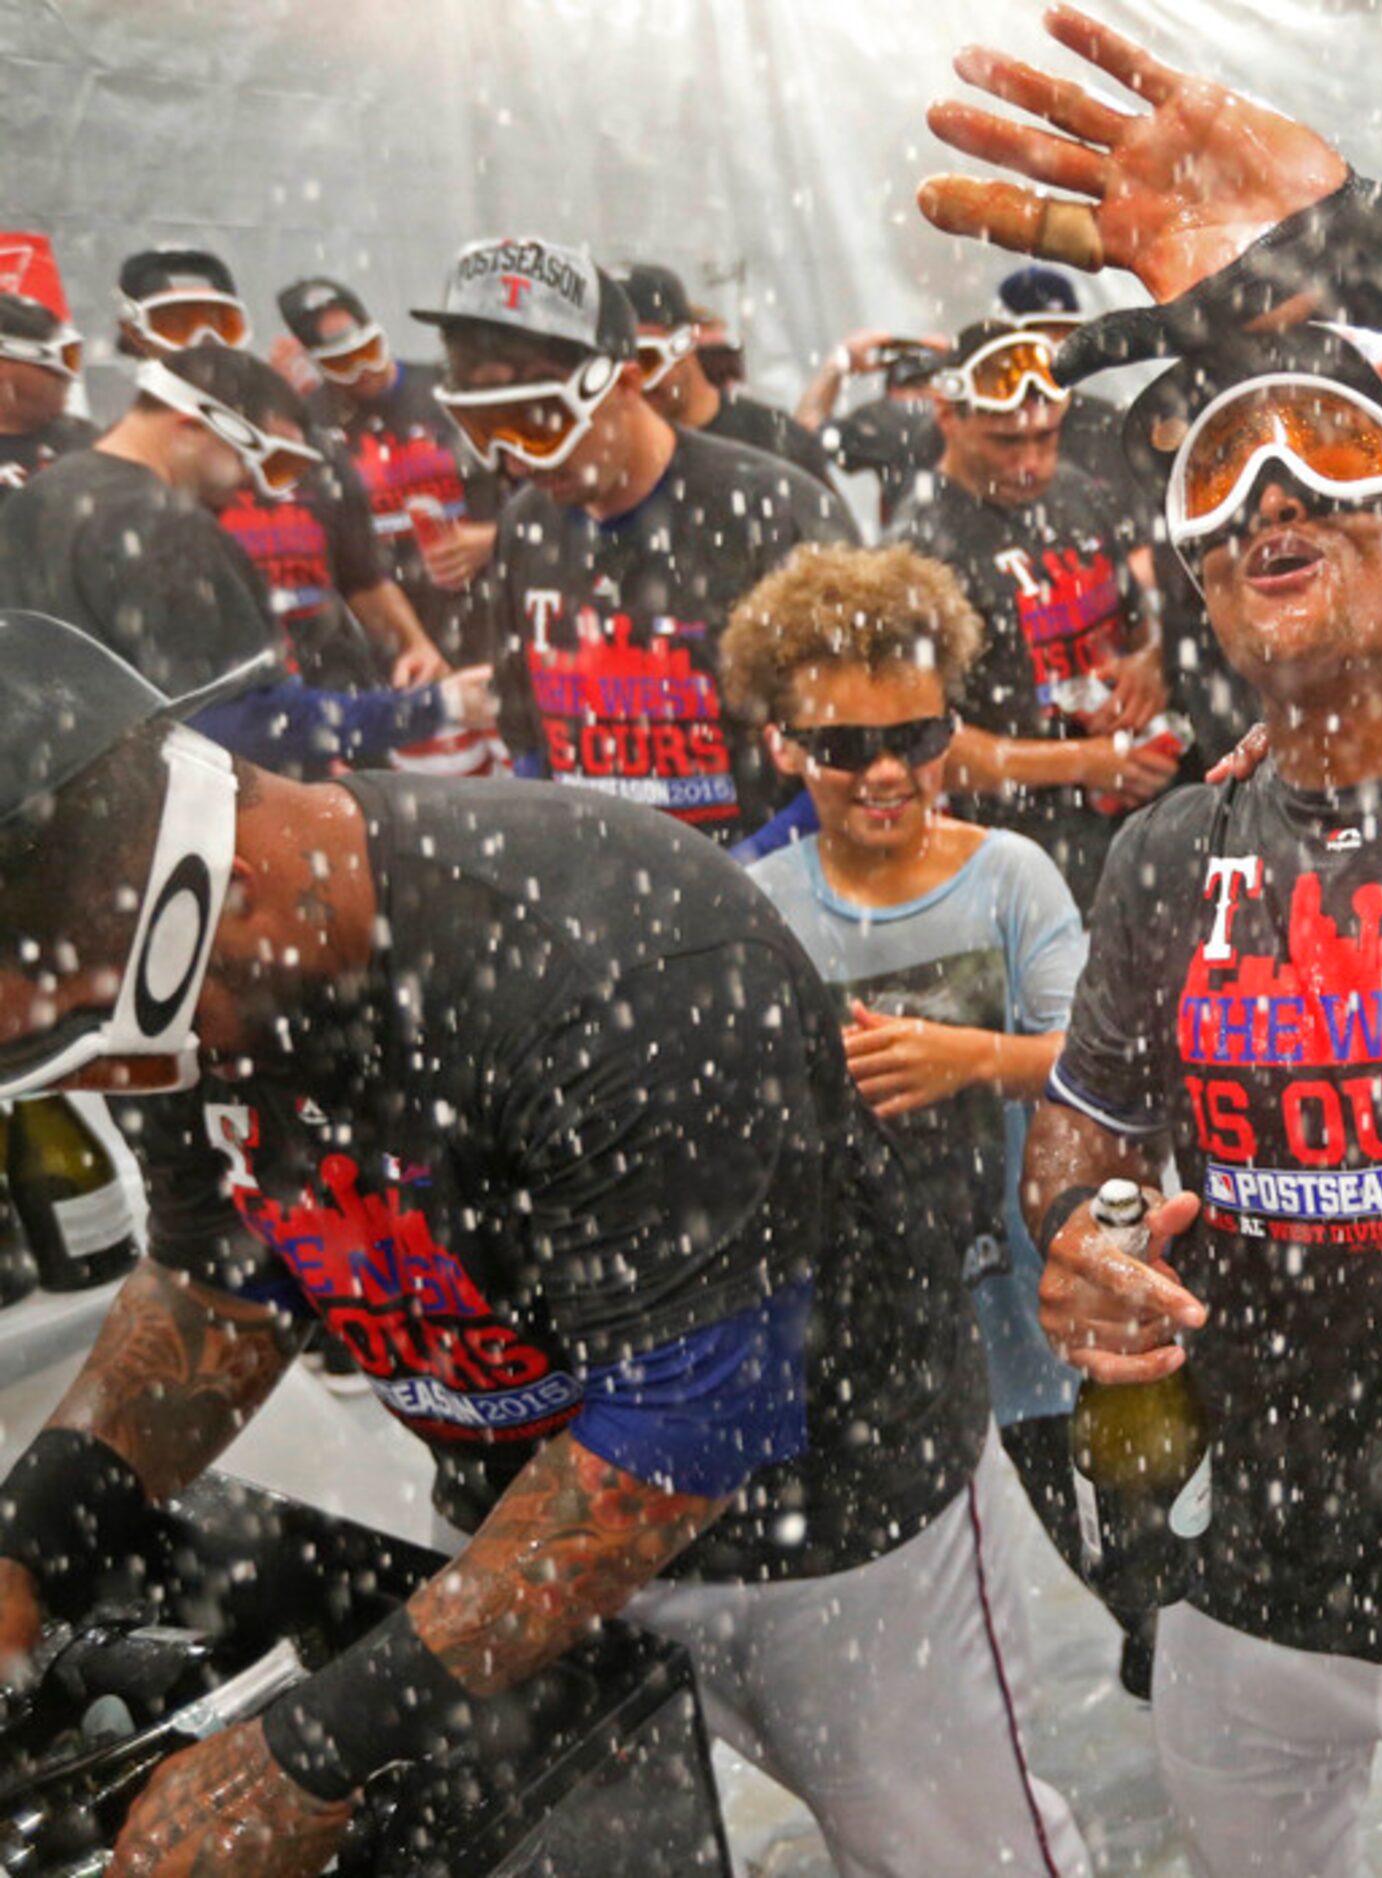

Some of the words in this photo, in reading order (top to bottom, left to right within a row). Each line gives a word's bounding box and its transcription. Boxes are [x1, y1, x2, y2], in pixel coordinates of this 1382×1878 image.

[457, 242, 587, 309] POSTSEASON
[499, 274, 532, 310] T
[994, 548, 1032, 596] T
[524, 588, 562, 653] T
[580, 722, 731, 777] OURS
[1202, 855, 1263, 961] T
[1182, 997, 1304, 1061] THE
[1185, 1076, 1257, 1162] IS
[477, 1378, 570, 1422] 2015
